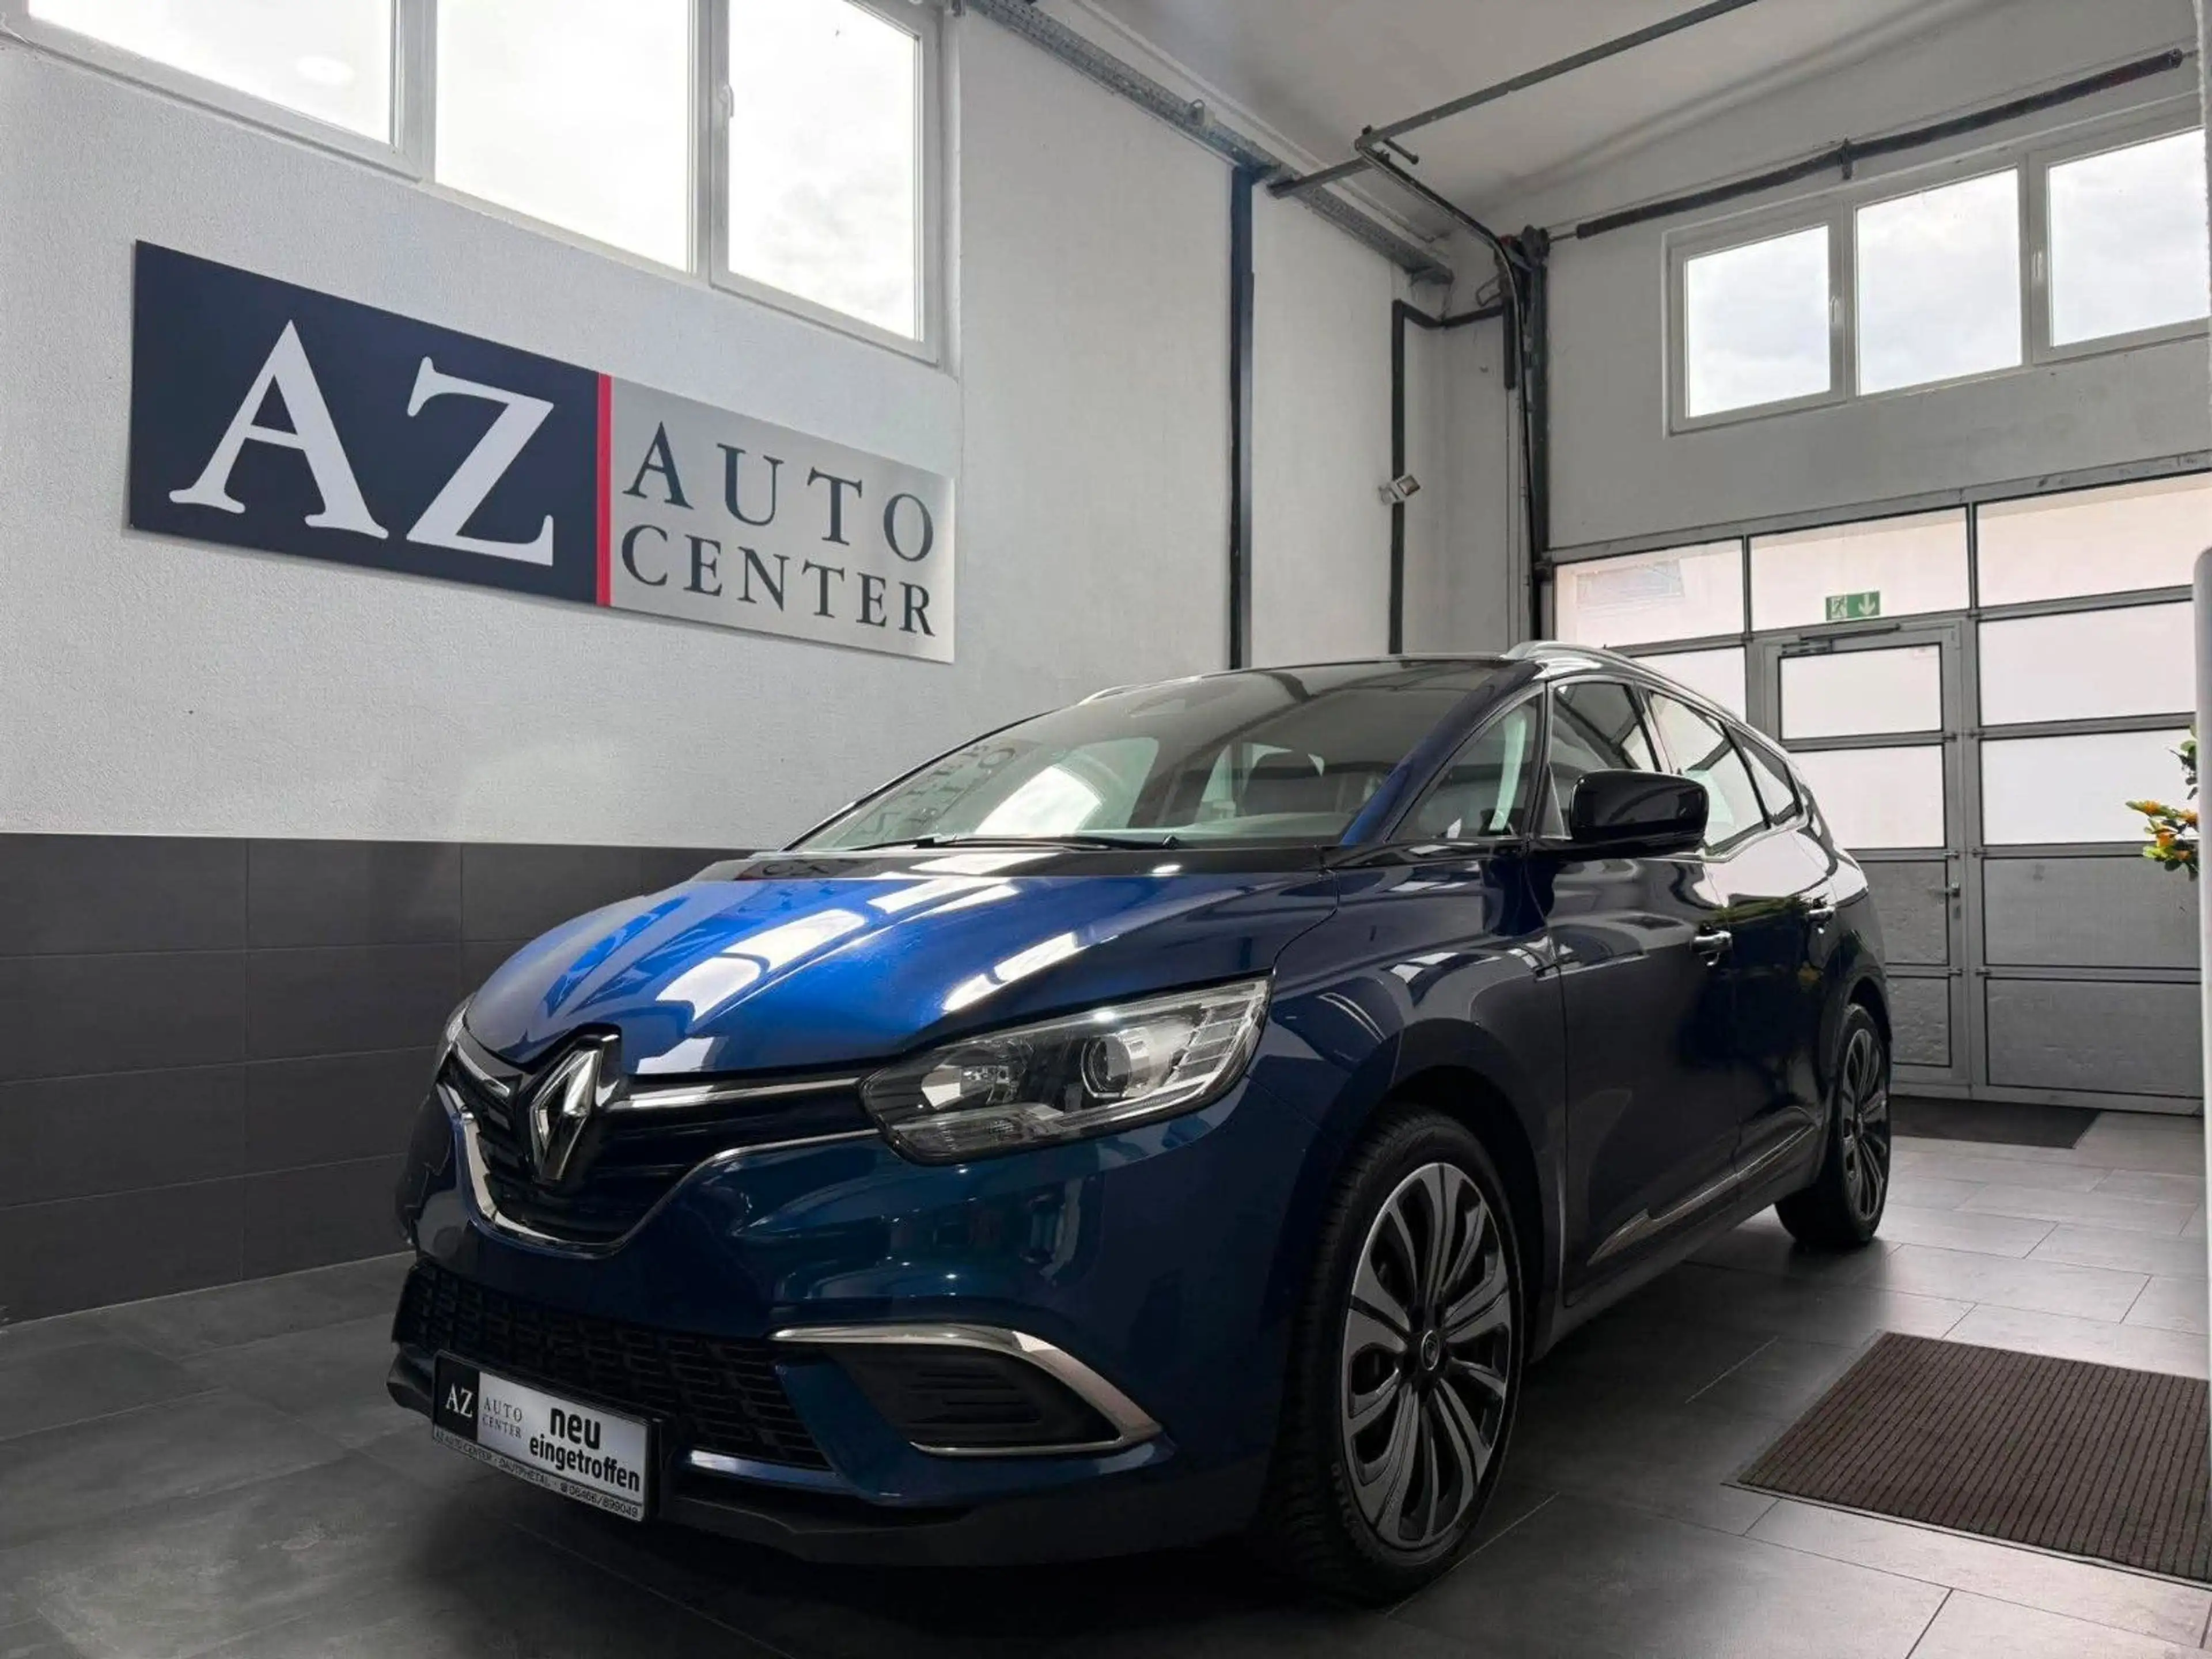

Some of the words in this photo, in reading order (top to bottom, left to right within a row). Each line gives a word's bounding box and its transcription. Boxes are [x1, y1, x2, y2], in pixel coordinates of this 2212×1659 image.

[169, 319, 554, 566] AZ
[622, 421, 933, 562] AUTO
[622, 524, 935, 636] CENTER
[445, 1383, 472, 1418] AZ
[483, 1397, 522, 1423] AUTO
[483, 1414, 522, 1439] CENTER
[550, 1407, 600, 1449] neu
[529, 1434, 639, 1492] eingetroffen
